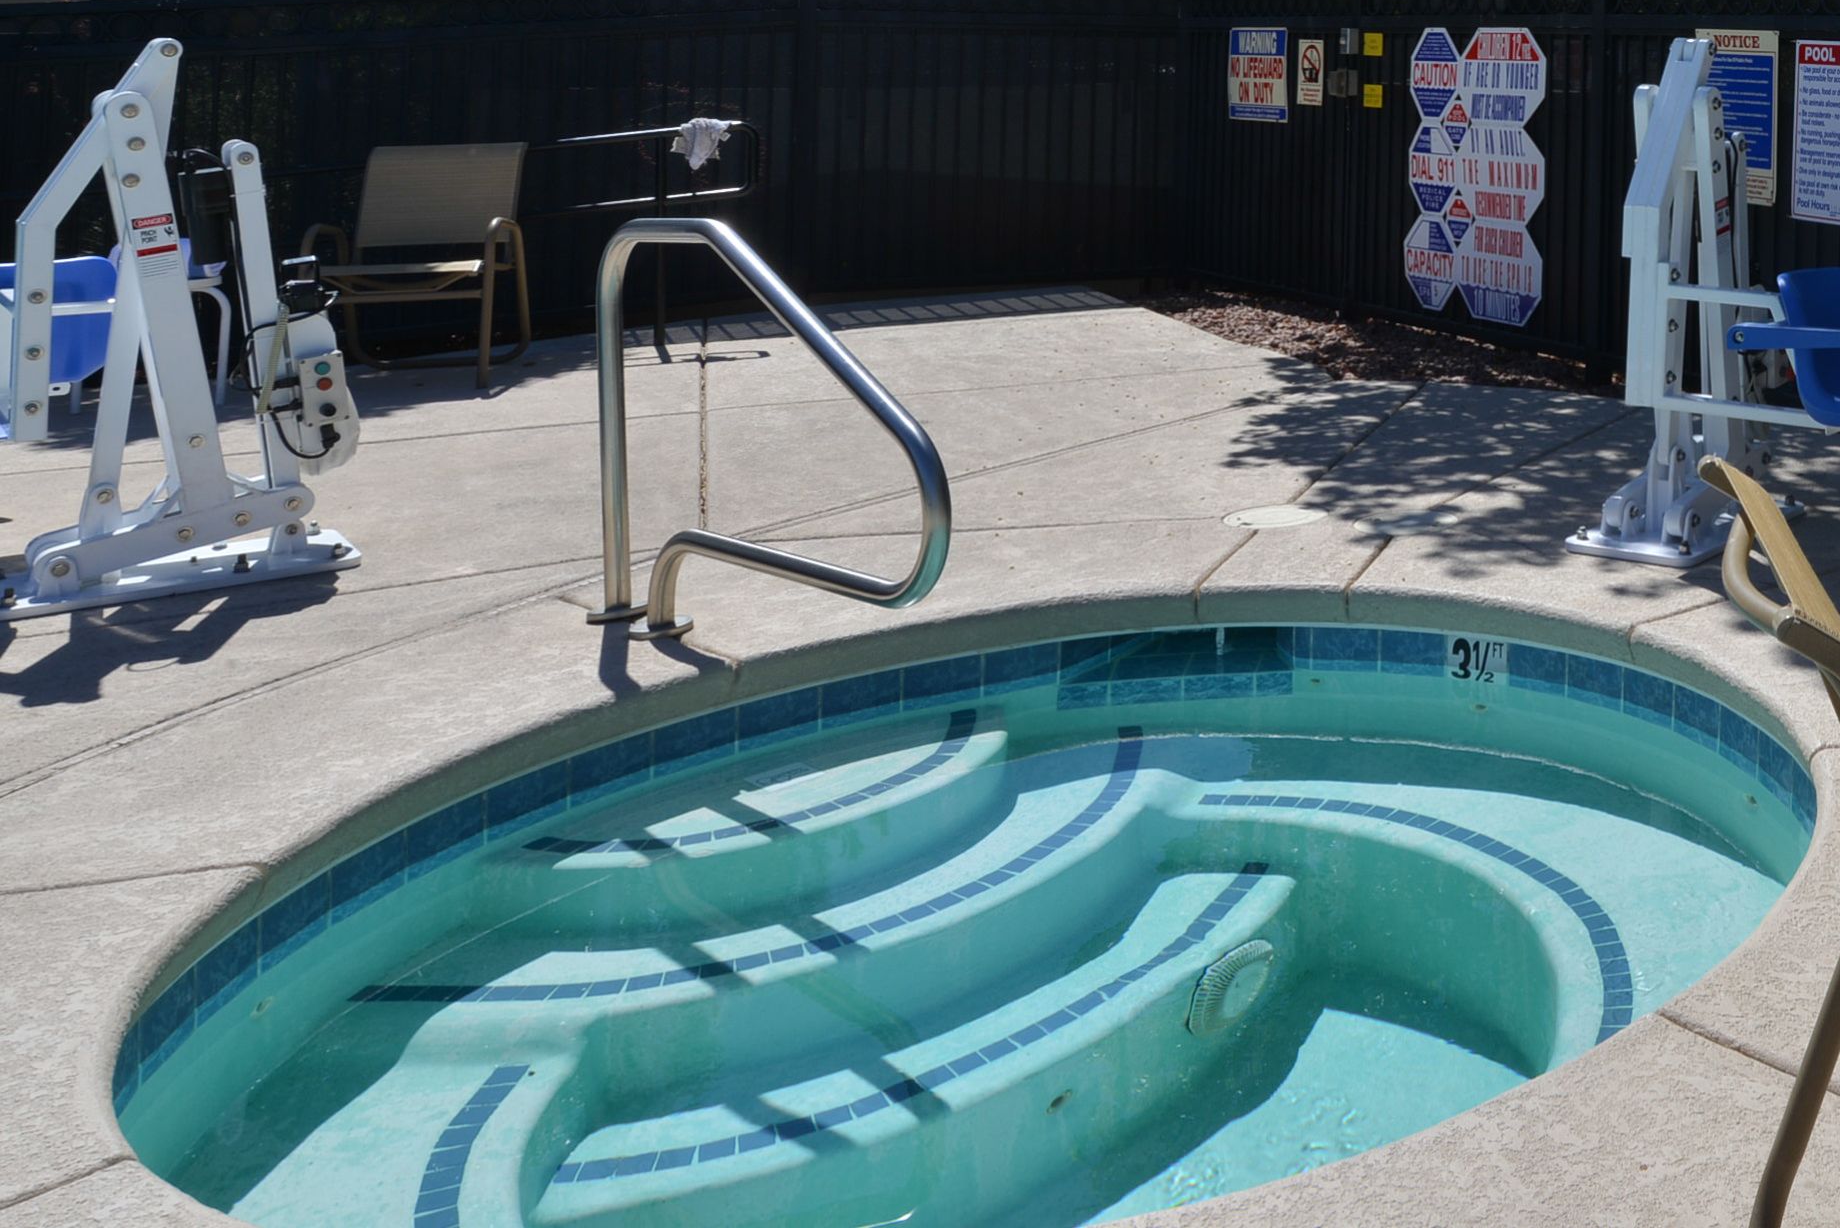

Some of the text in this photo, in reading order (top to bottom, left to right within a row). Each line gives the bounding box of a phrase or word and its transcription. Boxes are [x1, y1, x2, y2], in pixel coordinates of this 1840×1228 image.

[1238, 31, 1277, 54] WARNING
[1512, 33, 1522, 59] 12
[1713, 34, 1760, 49] NOTICE
[1804, 46, 1836, 62] POOL
[1231, 57, 1284, 79] NO LIFEGUARD
[1413, 63, 1458, 86] CAUTION
[1476, 62, 1489, 88] AGE
[1491, 62, 1500, 89] OR
[1505, 62, 1539, 90] YOUNGER
[1238, 82, 1273, 104] ON DUTY
[1411, 154, 1455, 183] DIAL 911
[1462, 158, 1538, 191] THE MAXIMUM
[1419, 186, 1446, 196] MEDICAL
[1421, 194, 1443, 203] POLICE
[1797, 197, 1830, 211] Pool Hours
[137, 217, 167, 227] DANGER
[1406, 249, 1454, 279] CAPACITY
[1507, 262, 1520, 291] SPA
[1474, 289, 1521, 322] 10 MINUTES
[1493, 642, 1504, 659] FT
